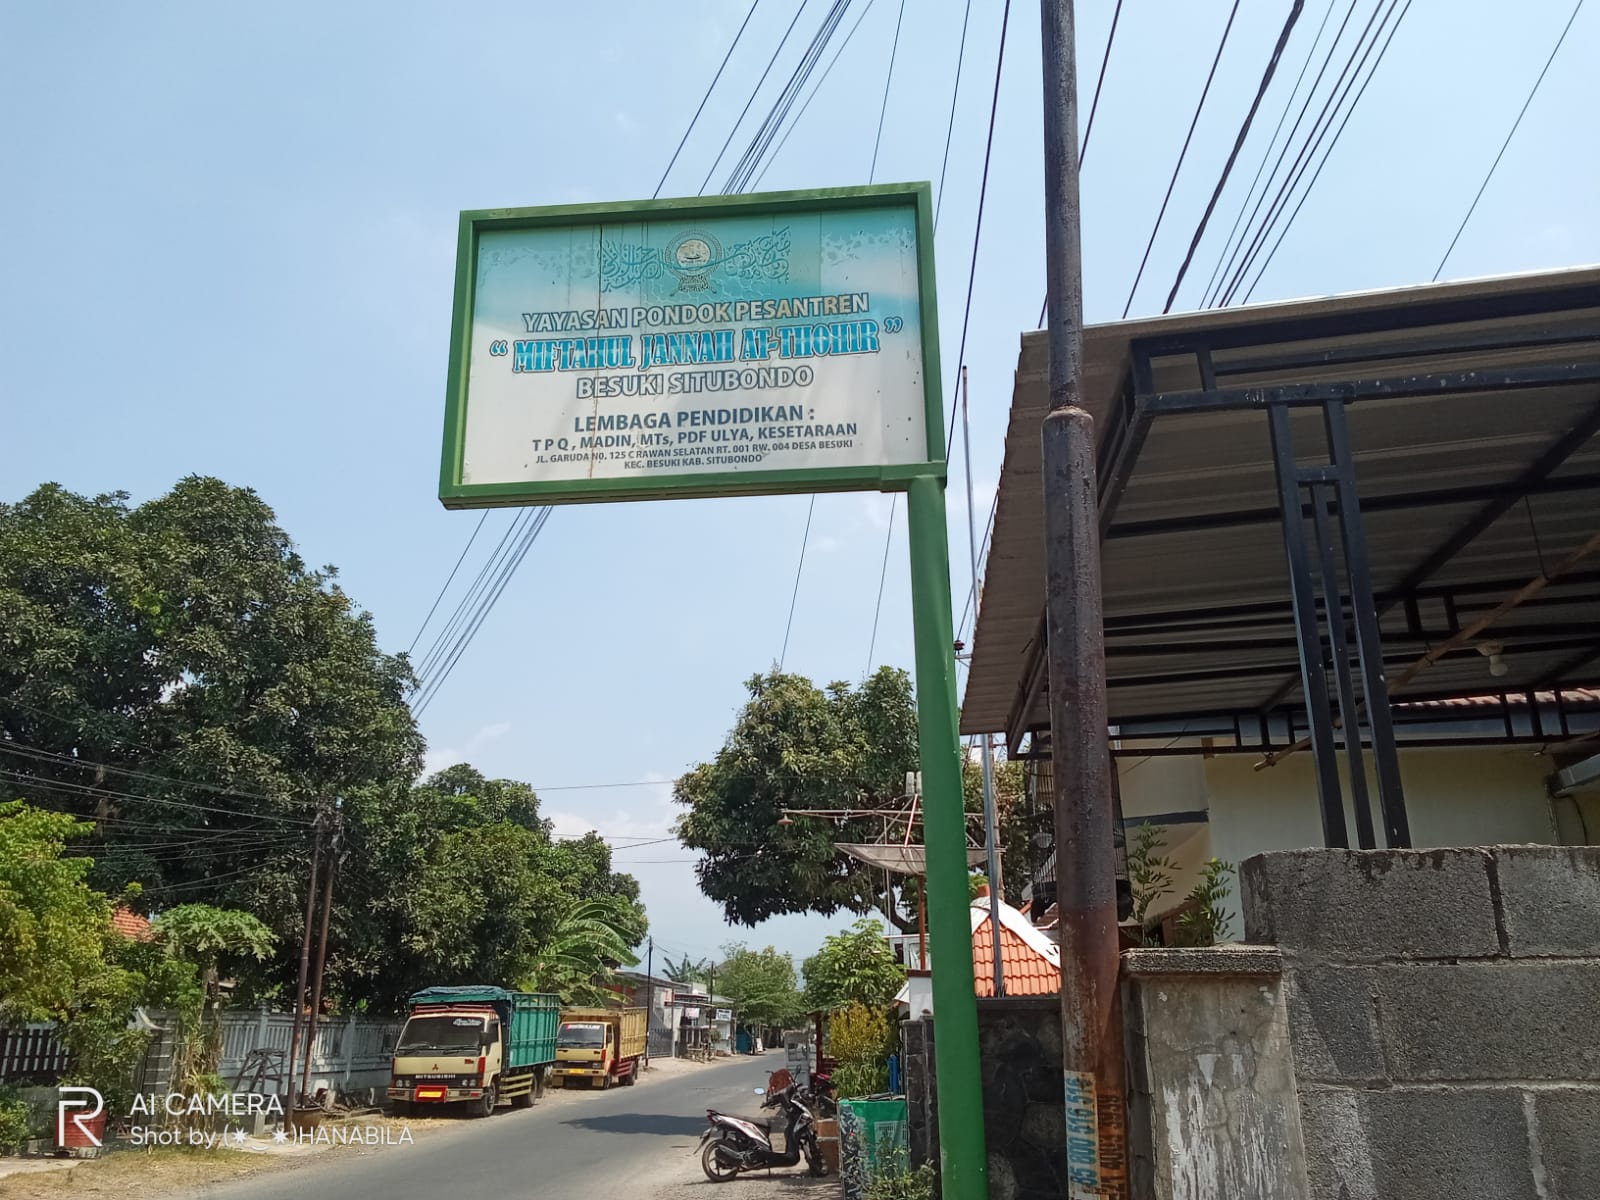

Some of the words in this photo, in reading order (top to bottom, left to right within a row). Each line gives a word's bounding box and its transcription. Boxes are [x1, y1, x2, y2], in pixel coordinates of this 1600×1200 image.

[522, 308, 628, 332] YAYASAN
[632, 302, 732, 327] PONDOK
[735, 292, 869, 321] PESANTREN
[513, 335, 636, 373] MIFTAHUL
[638, 329, 735, 371] JANNAH
[739, 319, 880, 362] AT-THOHIR
[576, 373, 664, 399] BESUKI
[668, 365, 814, 394] SITUBONDO
[574, 412, 671, 432] LEMBAGA
[677, 405, 803, 427] PENDIDIKAN
[580, 434, 636, 449] MADIN,
[640, 432, 674, 446] MTs,
[678, 430, 706, 444] PDF
[711, 427, 754, 442] ULYA,
[758, 422, 857, 440] KESETARAAN
[536, 455, 549, 464] JL.
[550, 452, 589, 463] GARUDA
[610, 450, 626, 460] 125
[636, 448, 671, 459] RAWAN
[673, 446, 714, 457] SELATAN
[716, 444, 731, 454] RT.
[732, 444, 749, 453] 001
[772, 441, 790, 451] 004
[792, 440, 817, 450] DESA
[819, 439, 853, 449] BESUKI
[624, 460, 645, 469] KEC.
[647, 458, 681, 468] BESUKI
[682, 456, 705, 466] KAB.
[706, 454, 762, 465] SITUBONDO
